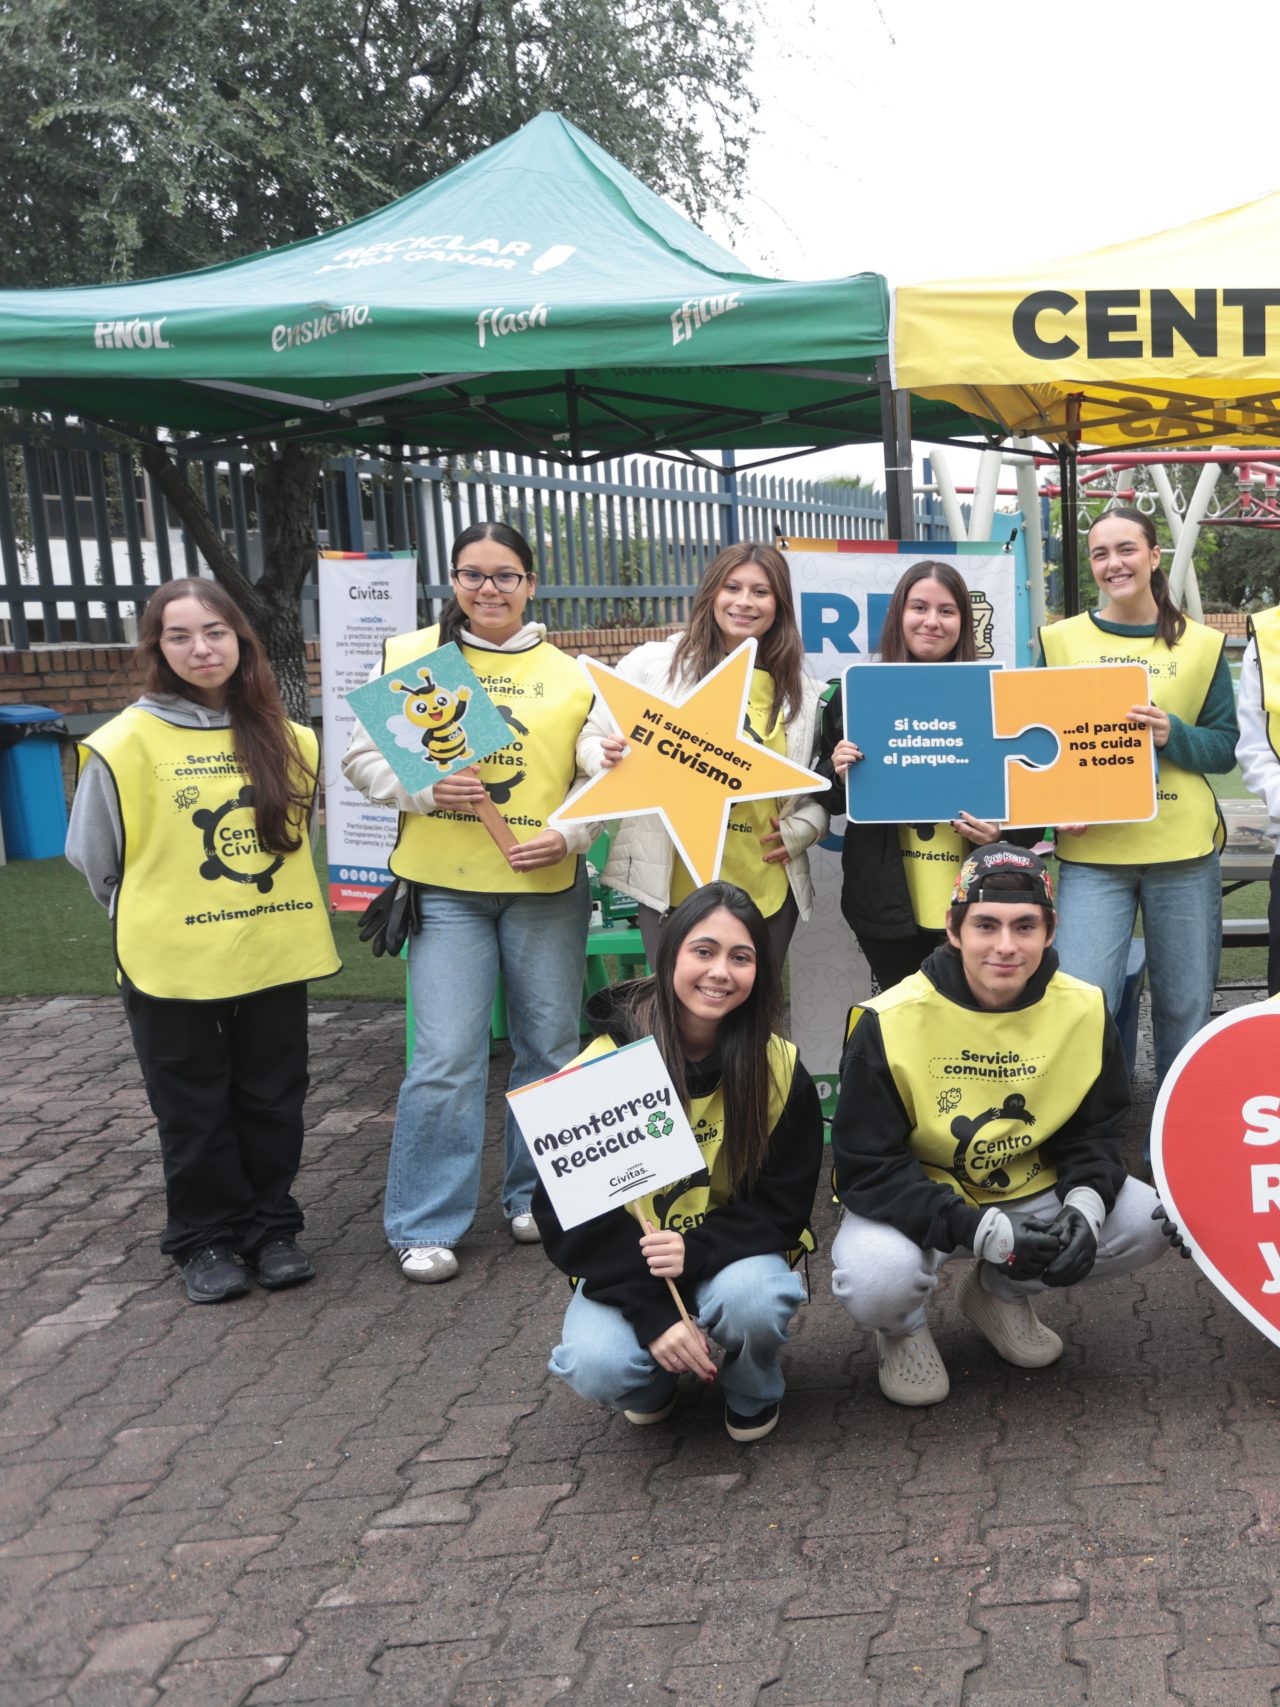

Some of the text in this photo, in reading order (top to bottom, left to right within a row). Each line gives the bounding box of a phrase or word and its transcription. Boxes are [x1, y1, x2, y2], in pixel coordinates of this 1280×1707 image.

[402, 250, 518, 270] GANAR
[475, 302, 548, 348] flash
[1099, 655, 1148, 666] Servicio
[476, 675, 512, 685] vicio
[894, 718, 957, 731] Si todos
[1063, 721, 1147, 736] ...el parque
[642, 708, 753, 772] Mi superpoder:
[888, 734, 964, 748] cuidamos
[1069, 737, 1142, 751] nos cuida
[476, 752, 524, 766] vitas
[629, 724, 743, 792] El Civismo
[883, 752, 969, 768] el parque...
[1078, 754, 1135, 767] a todos
[174, 763, 249, 776] comunita
[184, 900, 314, 926] #CivismoPráctico
[961, 1049, 1020, 1065] Servicio
[943, 1062, 1037, 1078] comunitario
[551, 1126, 646, 1178] Recicla
[974, 1135, 1032, 1155] Centro
[627, 1161, 644, 1173] centro
[609, 1166, 648, 1188] Cívitas
